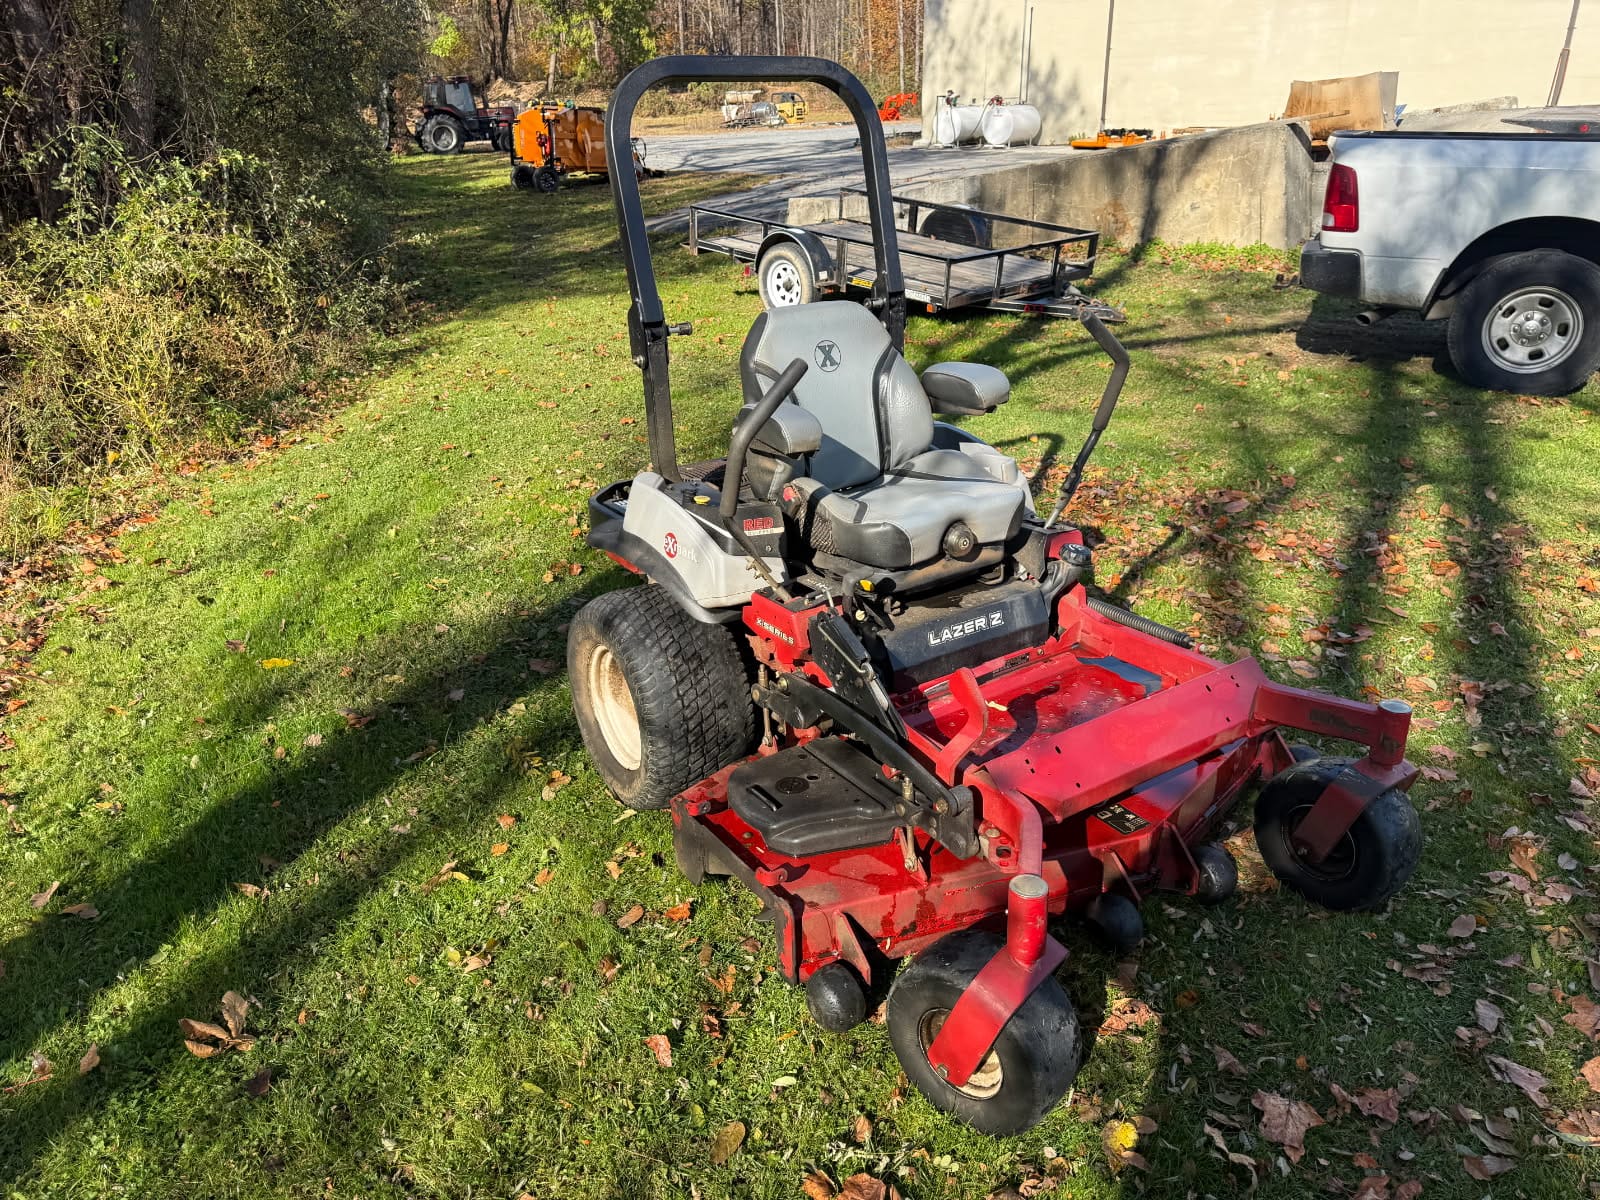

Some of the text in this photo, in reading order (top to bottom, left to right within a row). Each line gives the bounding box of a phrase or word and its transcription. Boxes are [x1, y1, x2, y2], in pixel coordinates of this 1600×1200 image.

[743, 516, 774, 531] RED
[928, 611, 1004, 646] LAZER Z
